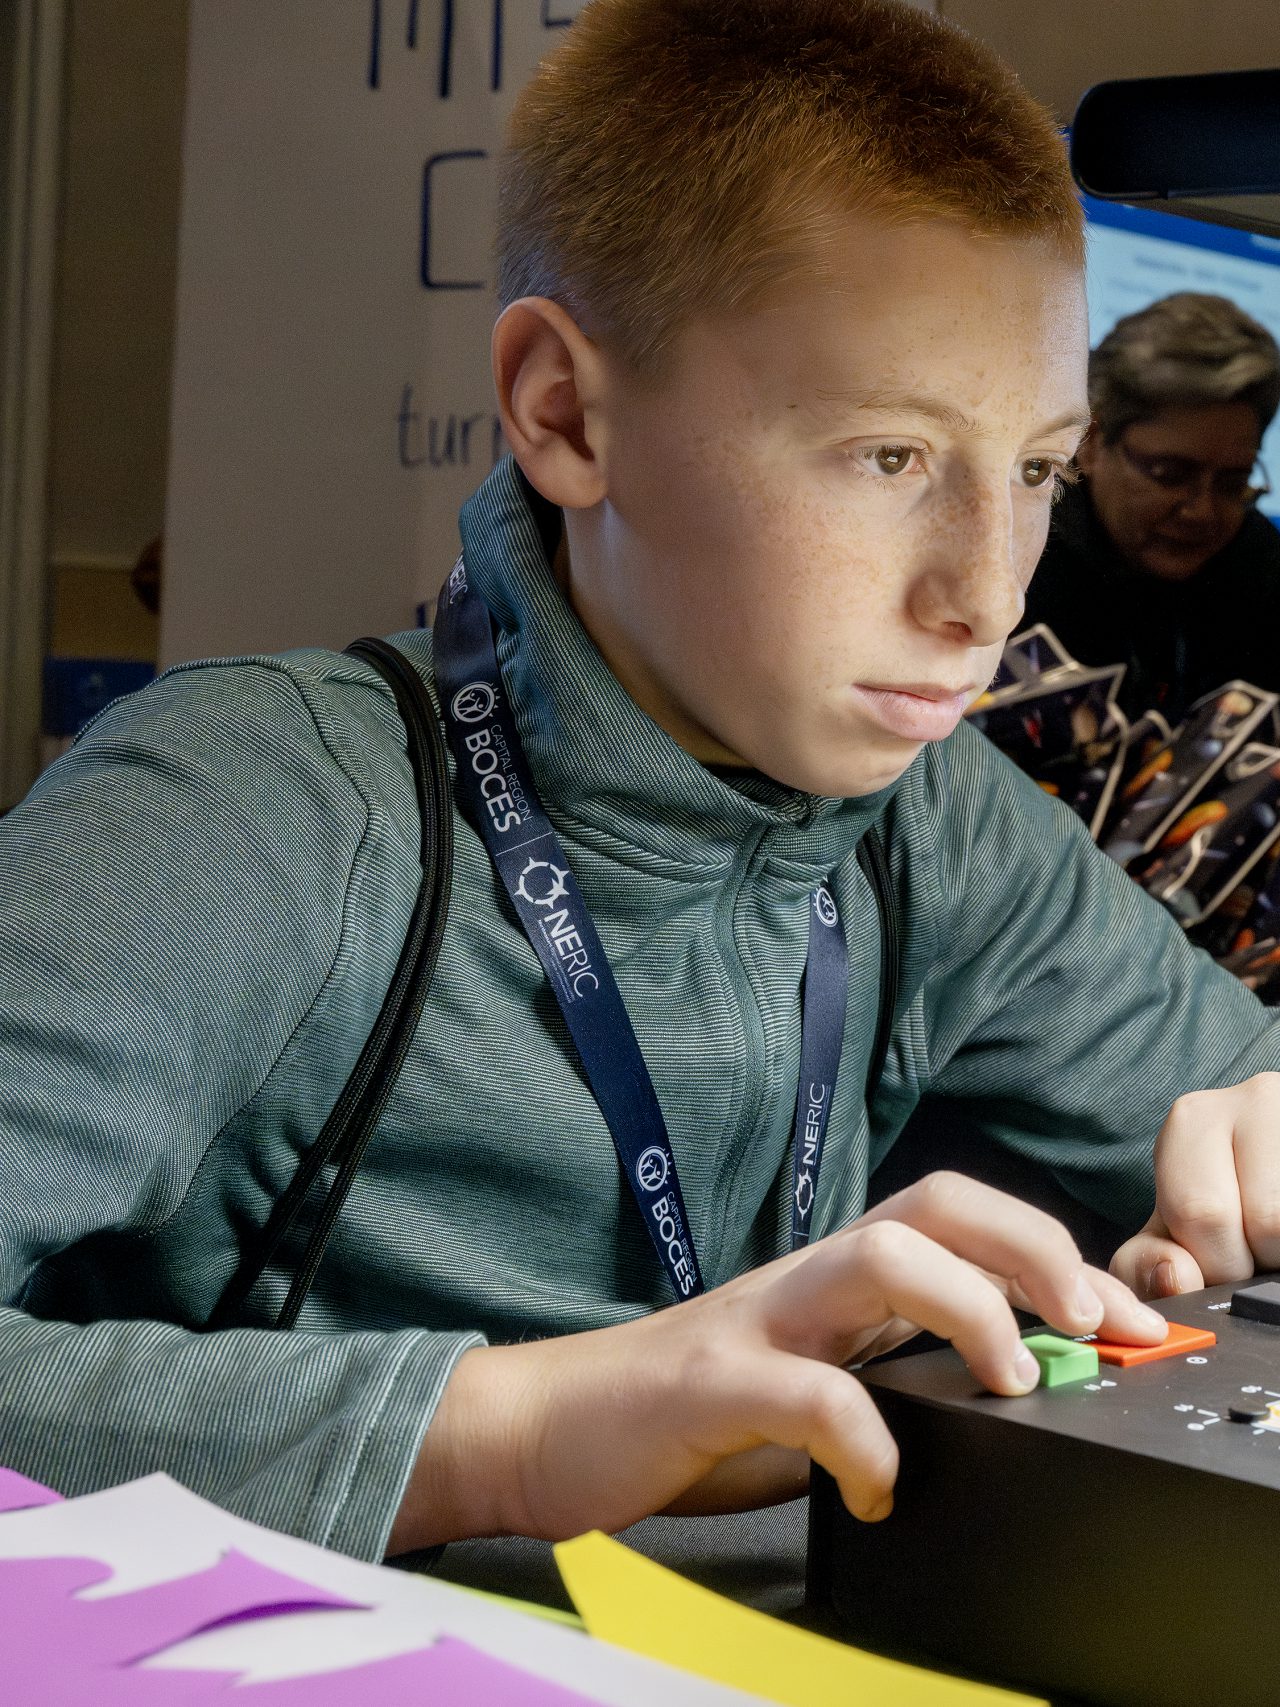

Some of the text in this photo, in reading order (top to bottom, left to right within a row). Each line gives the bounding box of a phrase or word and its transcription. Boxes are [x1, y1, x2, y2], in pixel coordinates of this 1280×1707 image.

[465, 729, 521, 832] BOCES
[491, 724, 533, 822] CAPITAL REGION
[544, 909, 598, 997] NERIC
[803, 1083, 825, 1165] NERIC
[652, 1196, 693, 1295] BOCES
